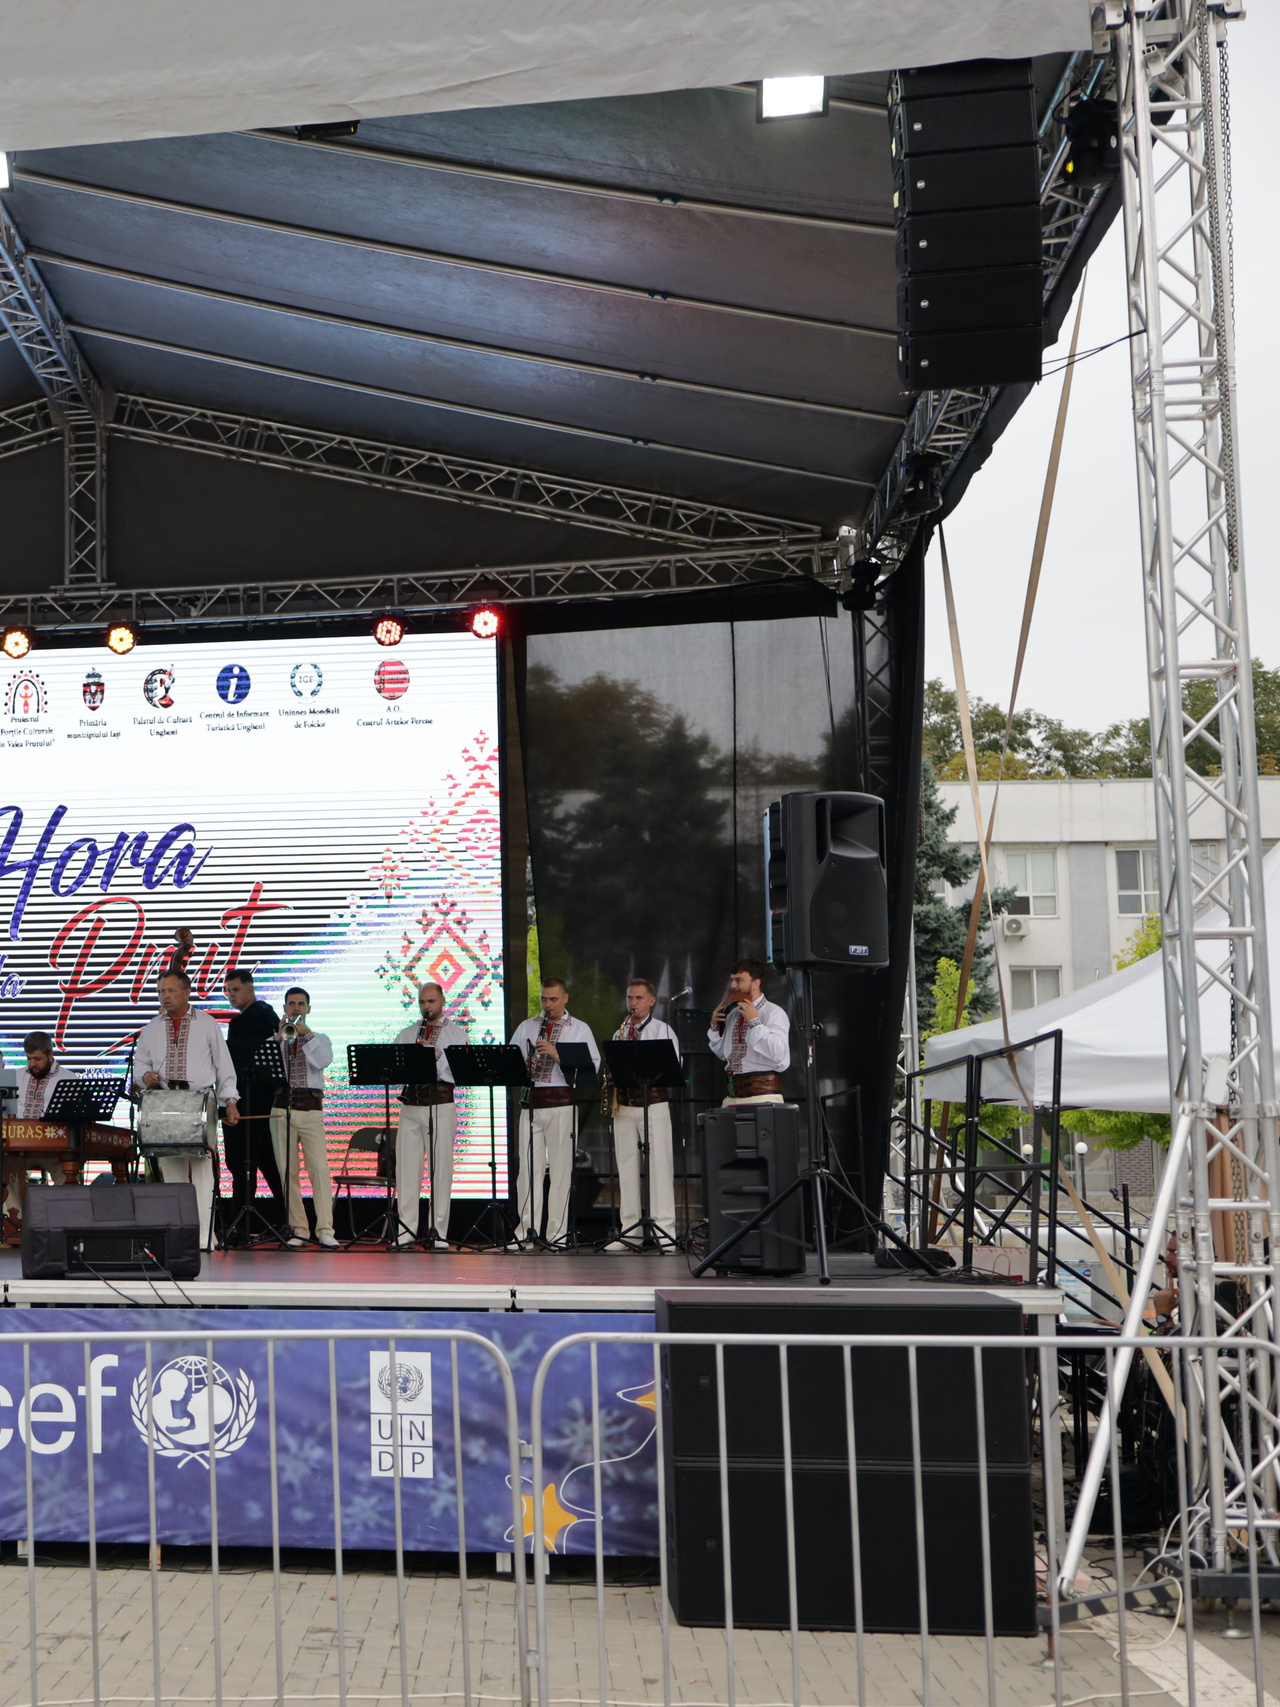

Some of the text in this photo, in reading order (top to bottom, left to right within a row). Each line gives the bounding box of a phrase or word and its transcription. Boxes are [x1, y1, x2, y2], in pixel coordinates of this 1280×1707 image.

[236, 710, 269, 718] Informare
[133, 717, 156, 725] Palatul
[236, 722, 265, 732] Ungheni
[150, 729, 178, 737] Ungheni
